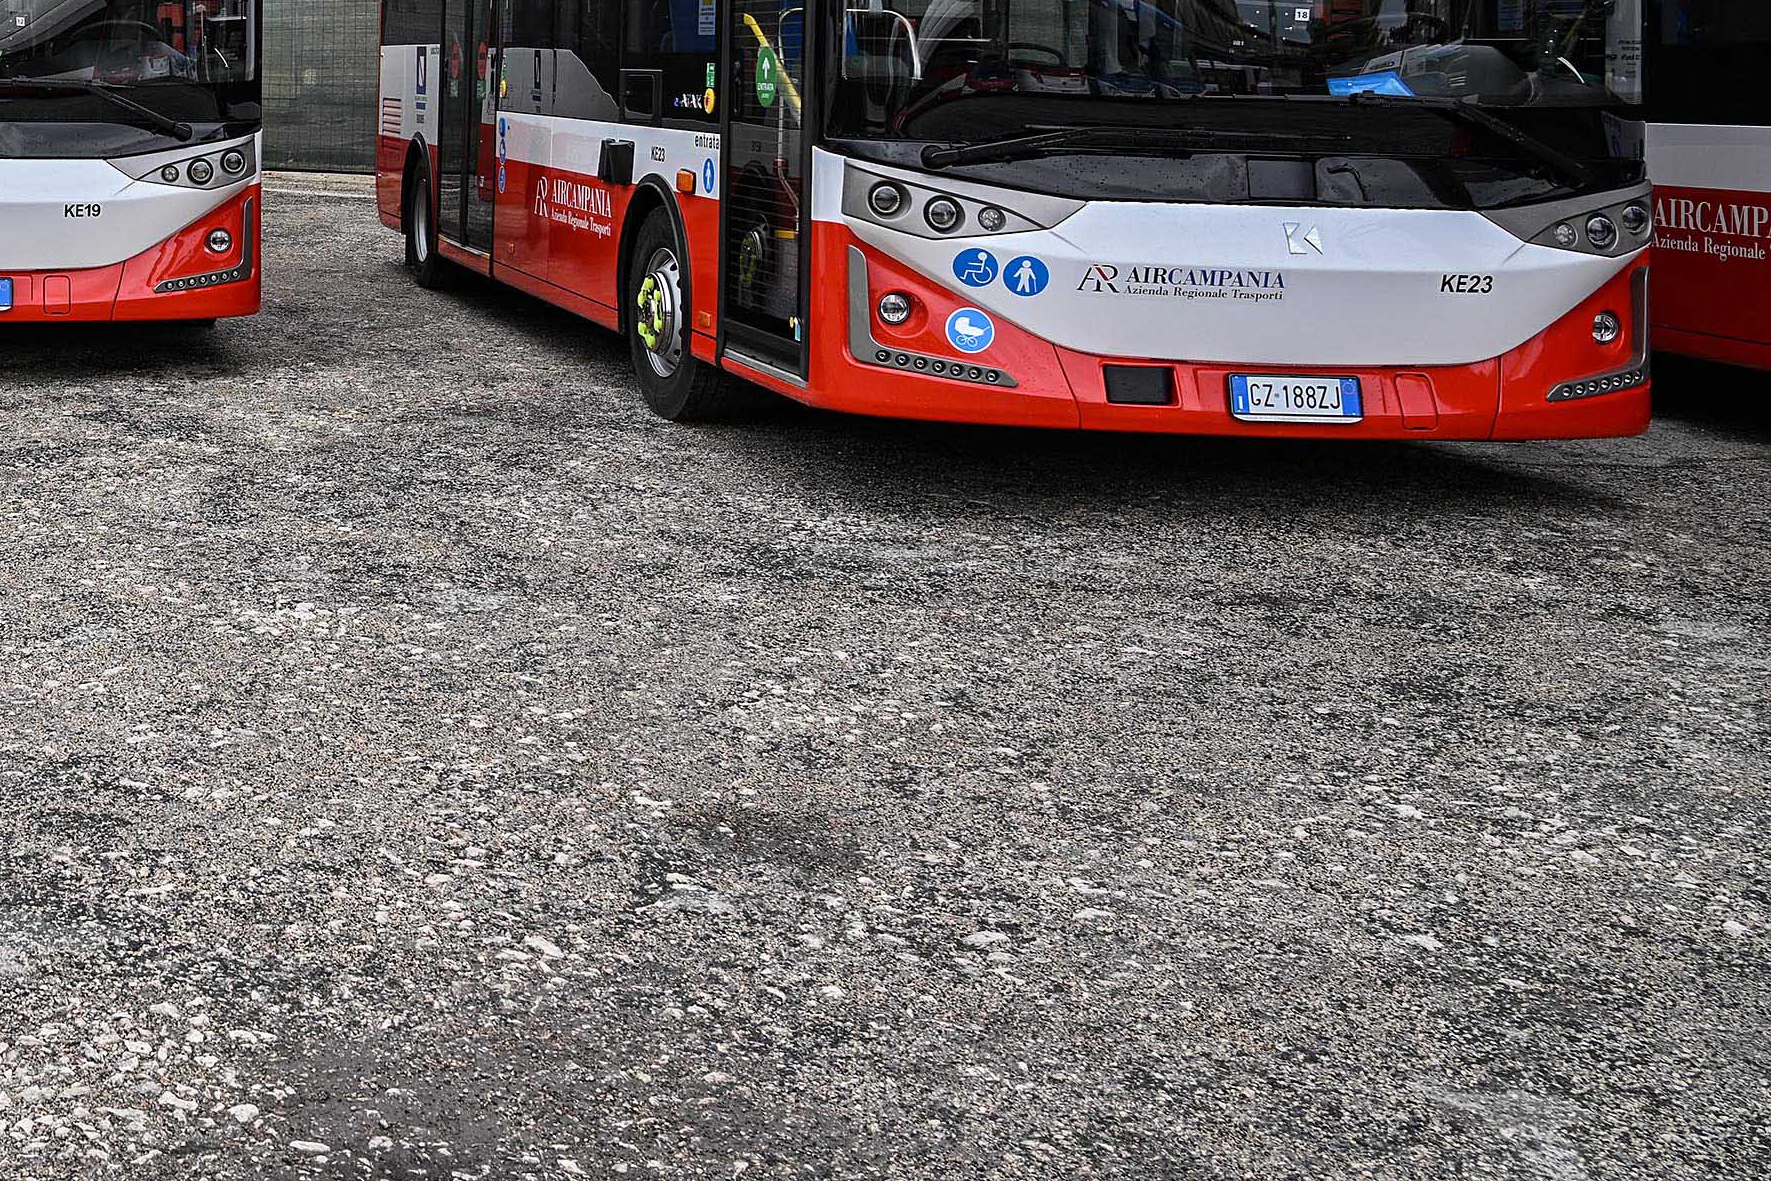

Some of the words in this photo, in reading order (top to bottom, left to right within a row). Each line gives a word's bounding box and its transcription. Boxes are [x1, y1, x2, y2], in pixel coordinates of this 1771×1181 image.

[694, 134, 720, 150] entrata
[651, 146, 666, 162] KE23
[551, 179, 612, 218] AIRCAMPANIA
[64, 203, 101, 217] KE19
[1654, 197, 1771, 238] AIRCAMP
[1652, 232, 1699, 252] Azienda
[1704, 237, 1766, 261] Regionale
[1126, 266, 1285, 289] AIRCAMPANIA
[1439, 274, 1494, 294] KE23
[1124, 285, 1169, 296] Azienda
[1173, 287, 1228, 299] Regionale
[1231, 289, 1283, 302] Trasporti
